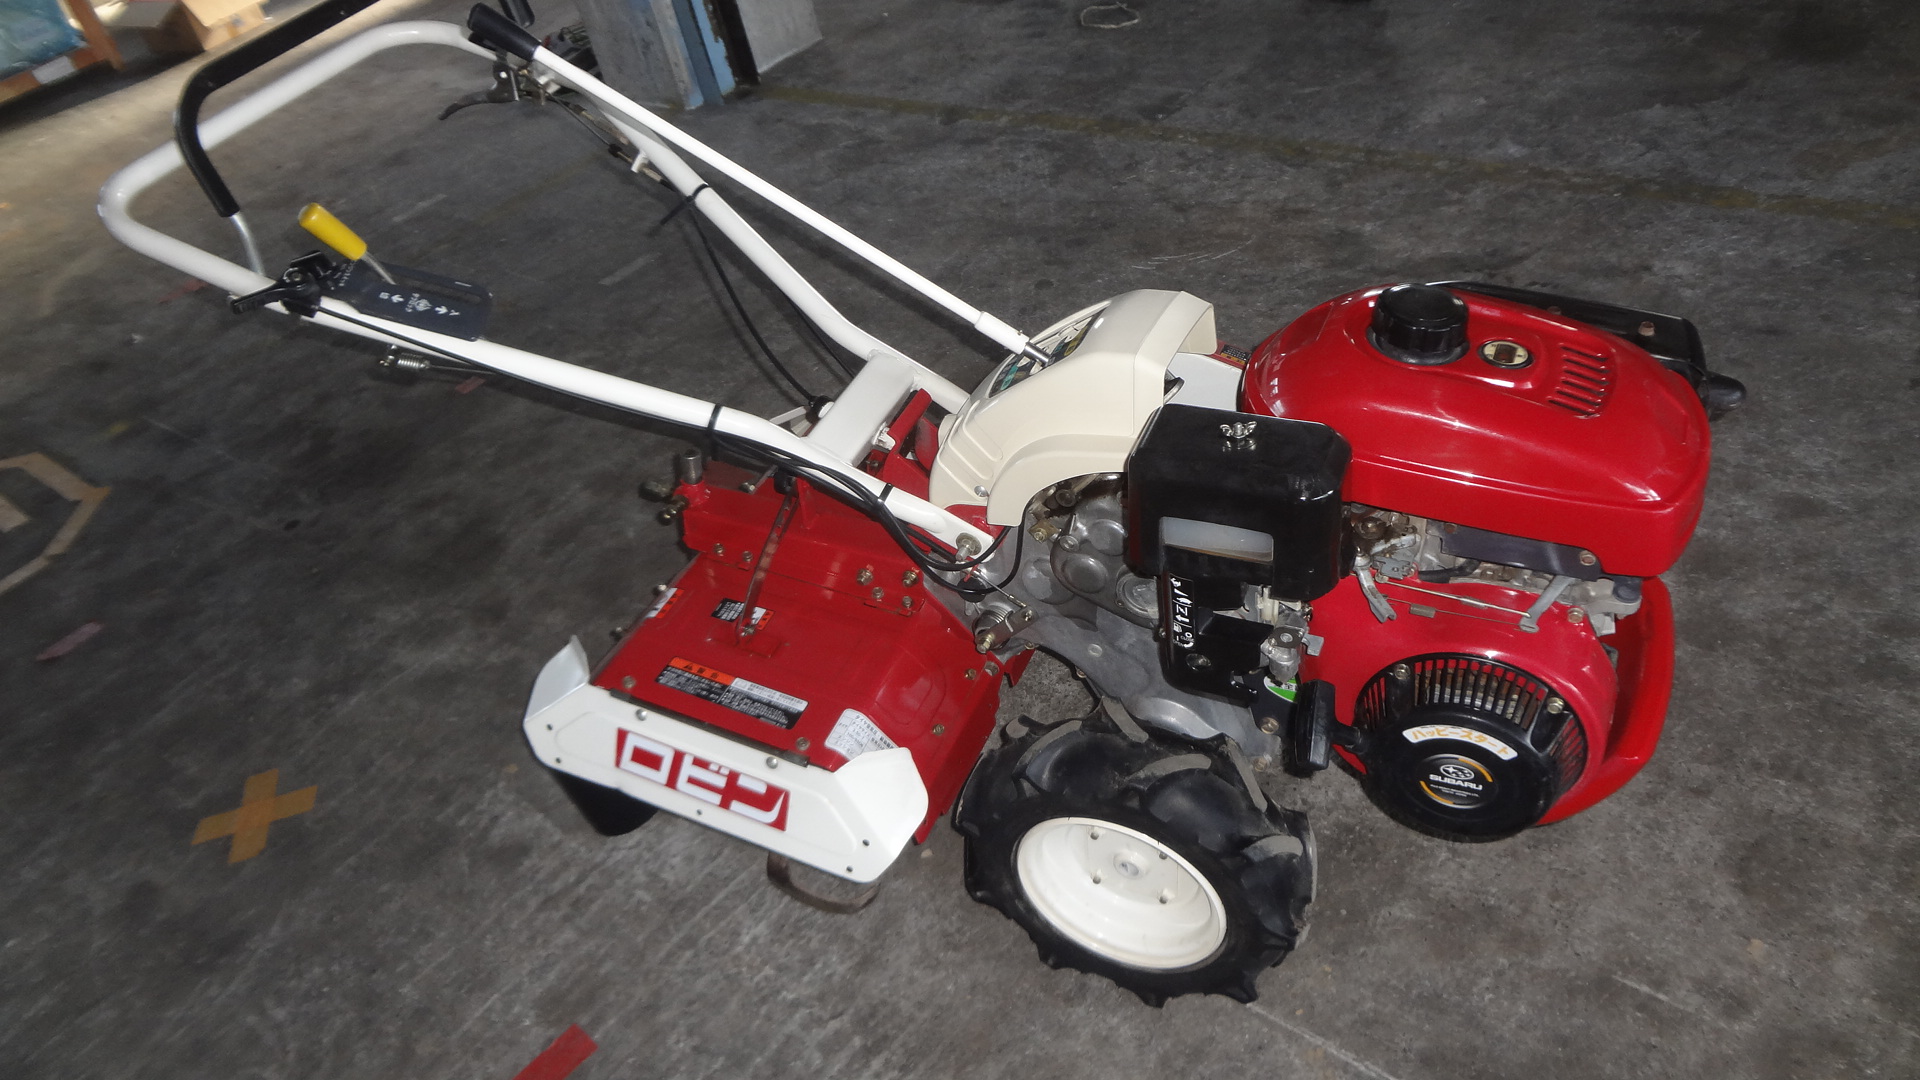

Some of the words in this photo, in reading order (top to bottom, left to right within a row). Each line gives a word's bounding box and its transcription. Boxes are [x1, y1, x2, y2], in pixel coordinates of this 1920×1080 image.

[1412, 727, 1509, 755] ハッピースタート
[619, 731, 786, 824] ロビン
[1429, 774, 1483, 790] SUBARU
